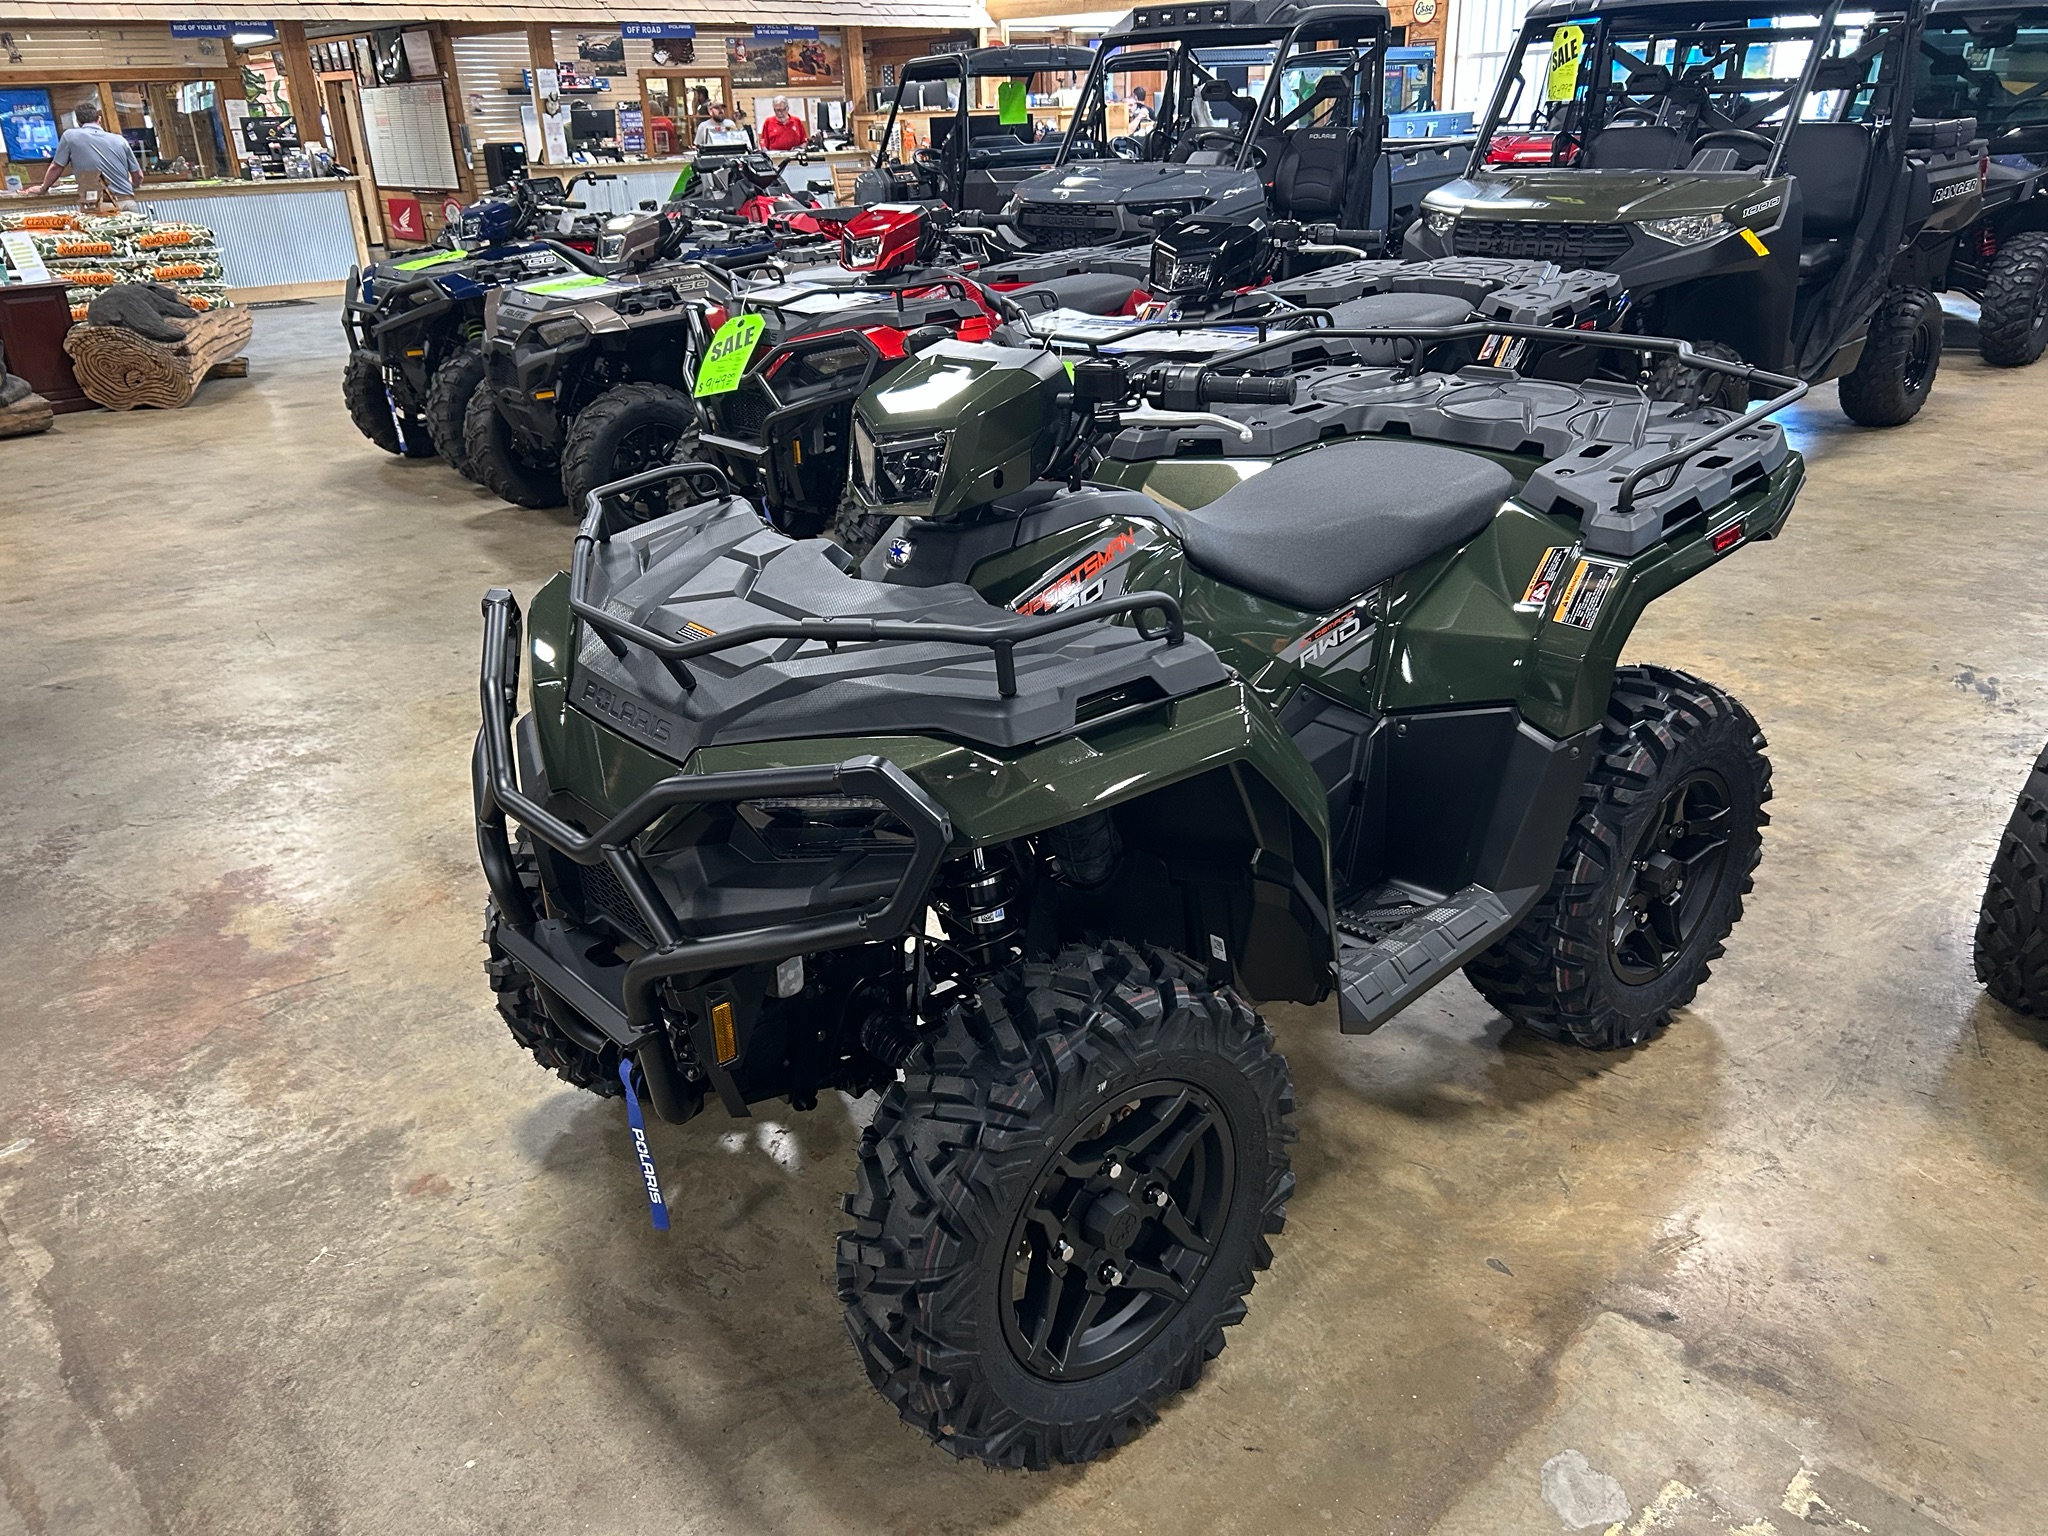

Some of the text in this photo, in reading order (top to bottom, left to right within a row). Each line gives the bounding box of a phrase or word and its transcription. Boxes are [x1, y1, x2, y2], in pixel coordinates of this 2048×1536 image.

[1415, 2, 1435, 15] Esso
[1552, 38, 1578, 72] SALE
[1931, 178, 1978, 203] RANGER
[1742, 195, 1781, 218] 1000
[26, 218, 51, 227] CLEAN
[1041, 217, 1084, 226] POLARIS
[61, 245, 109, 254] CLEAN CORN
[144, 233, 188, 245] CLEAN CORN
[1475, 238, 1583, 257] POLARIS
[157, 266, 200, 278] CLEAN CORN
[648, 272, 706, 287] SPORTSMAN
[710, 325, 756, 362] SALE
[1015, 525, 1135, 616] SPORTSMAN
[1565, 573, 1581, 601] WARNING
[1314, 609, 1357, 639] DEMAND
[1299, 617, 1361, 670] AWD
[580, 678, 673, 746] POLARIS
[631, 1126, 663, 1204] POLARIS
